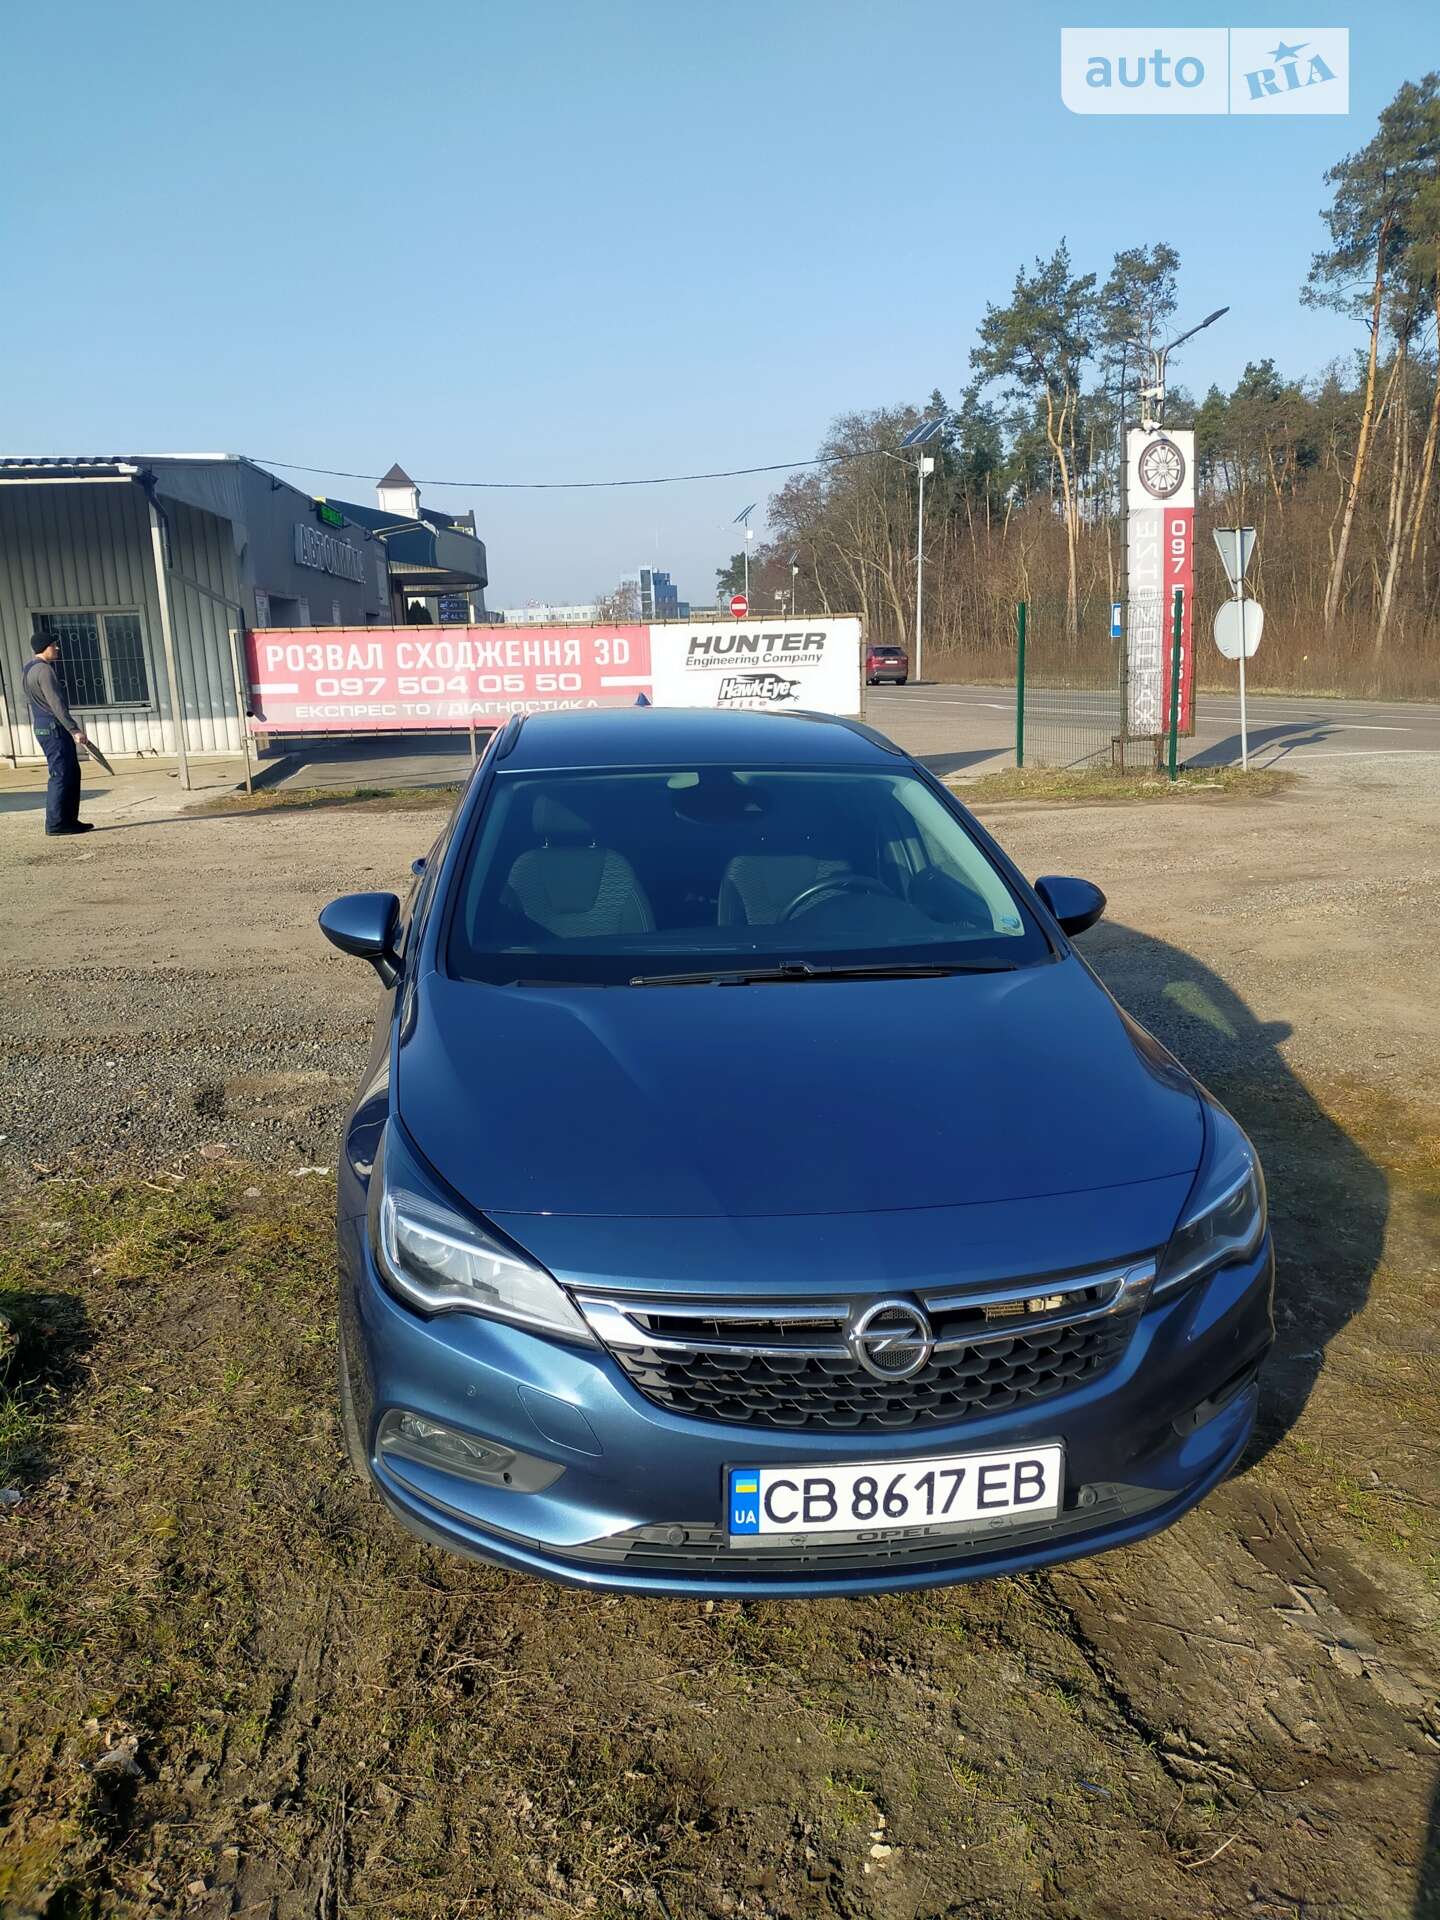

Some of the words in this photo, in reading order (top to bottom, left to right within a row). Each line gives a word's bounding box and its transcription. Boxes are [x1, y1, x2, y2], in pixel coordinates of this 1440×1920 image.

[1171, 520, 1186, 574] 097
[265, 643, 384, 672] РОЗВАЛ
[396, 639, 581, 671] СХОДЖЕННЯ
[593, 638, 630, 665] 3D
[688, 632, 827, 655] HUNTER
[685, 655, 760, 667] Engineering
[762, 653, 823, 665] Company
[315, 677, 386, 696] 097
[397, 675, 468, 694] 504
[478, 674, 525, 693] 05
[535, 673, 582, 691] 50
[718, 676, 790, 701] HawkEye
[295, 704, 397, 718] ЕКСПРЕС
[402, 703, 431, 715] ТО
[764, 1478, 838, 1524] CB
[851, 1468, 966, 1521] 8617
[976, 1459, 1046, 1510] EB
[735, 1510, 757, 1525] UA
[856, 1526, 942, 1541] OPEL
